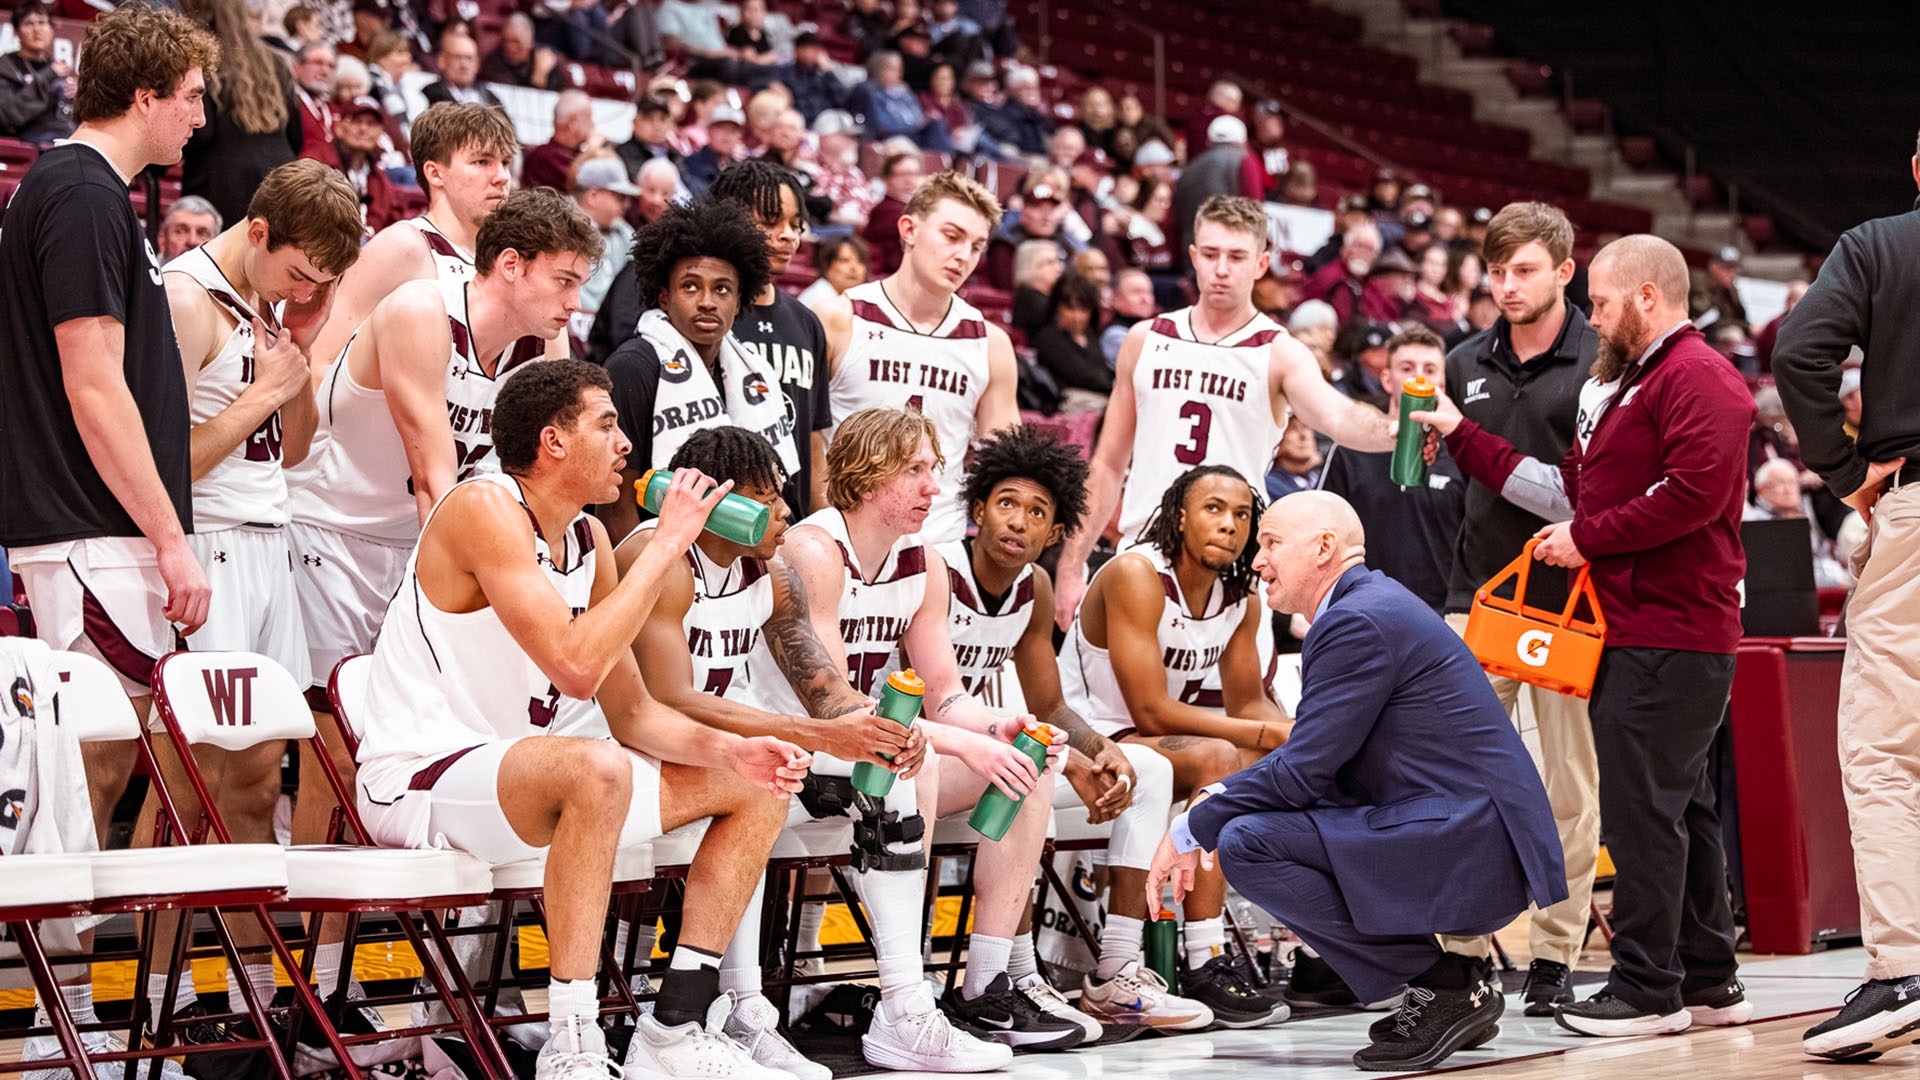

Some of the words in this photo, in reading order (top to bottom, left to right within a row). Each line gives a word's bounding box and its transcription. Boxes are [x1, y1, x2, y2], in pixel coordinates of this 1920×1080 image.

[869, 359, 911, 384] WEST
[920, 364, 968, 396] TEXAS
[1152, 369, 1193, 390] WEST
[1200, 371, 1247, 402] TEXAS
[1467, 378, 1487, 397] WT
[1174, 400, 1212, 466] 3
[1516, 629, 1554, 667] G
[202, 667, 258, 726] WT
